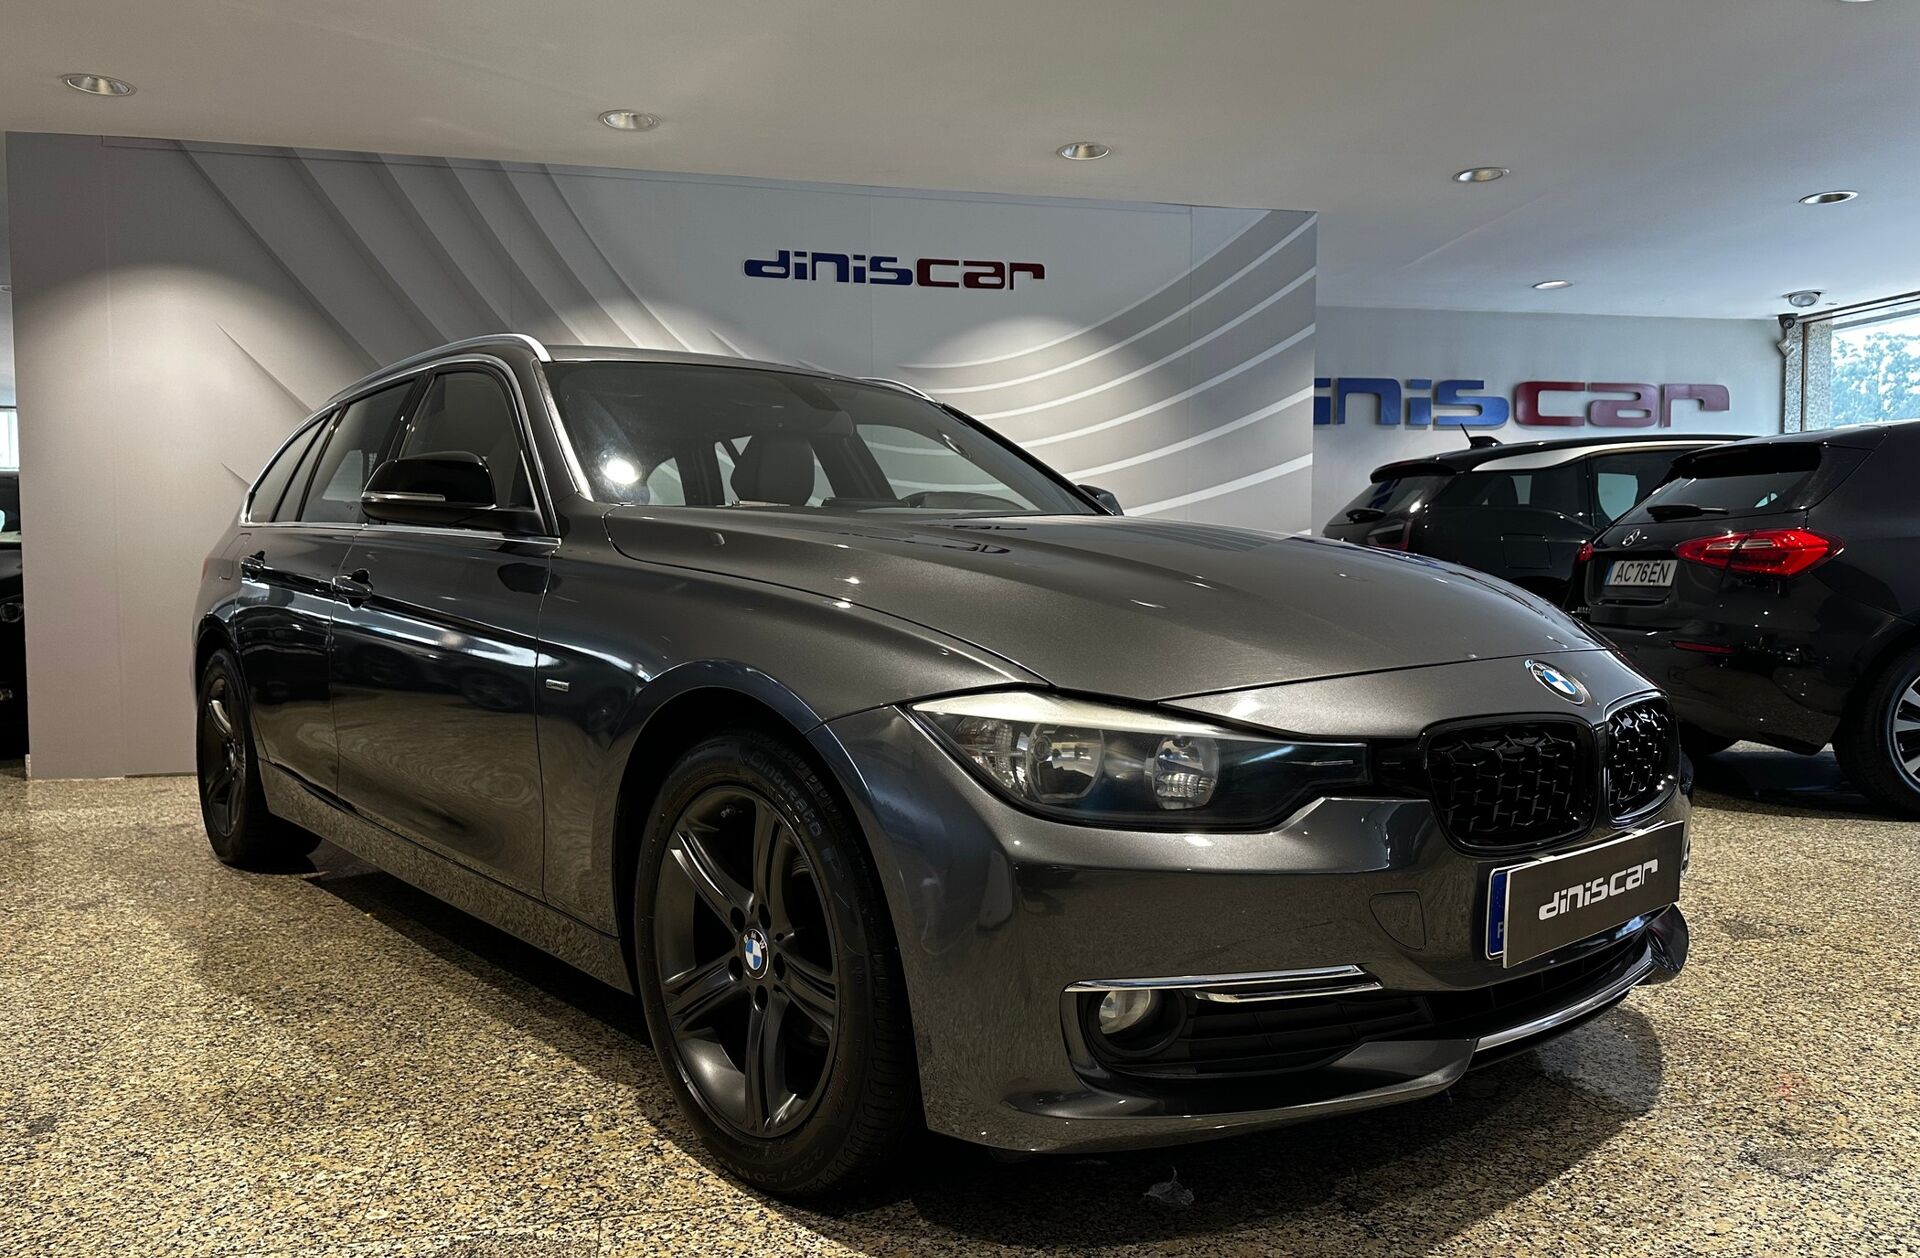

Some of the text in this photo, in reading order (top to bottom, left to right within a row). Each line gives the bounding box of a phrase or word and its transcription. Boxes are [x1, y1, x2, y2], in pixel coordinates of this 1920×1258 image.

[744, 249, 1046, 291] diniscar
[1313, 376, 1730, 429] iniscar
[1613, 562, 1671, 584] AC76EN
[1538, 858, 1659, 921] diniscar
